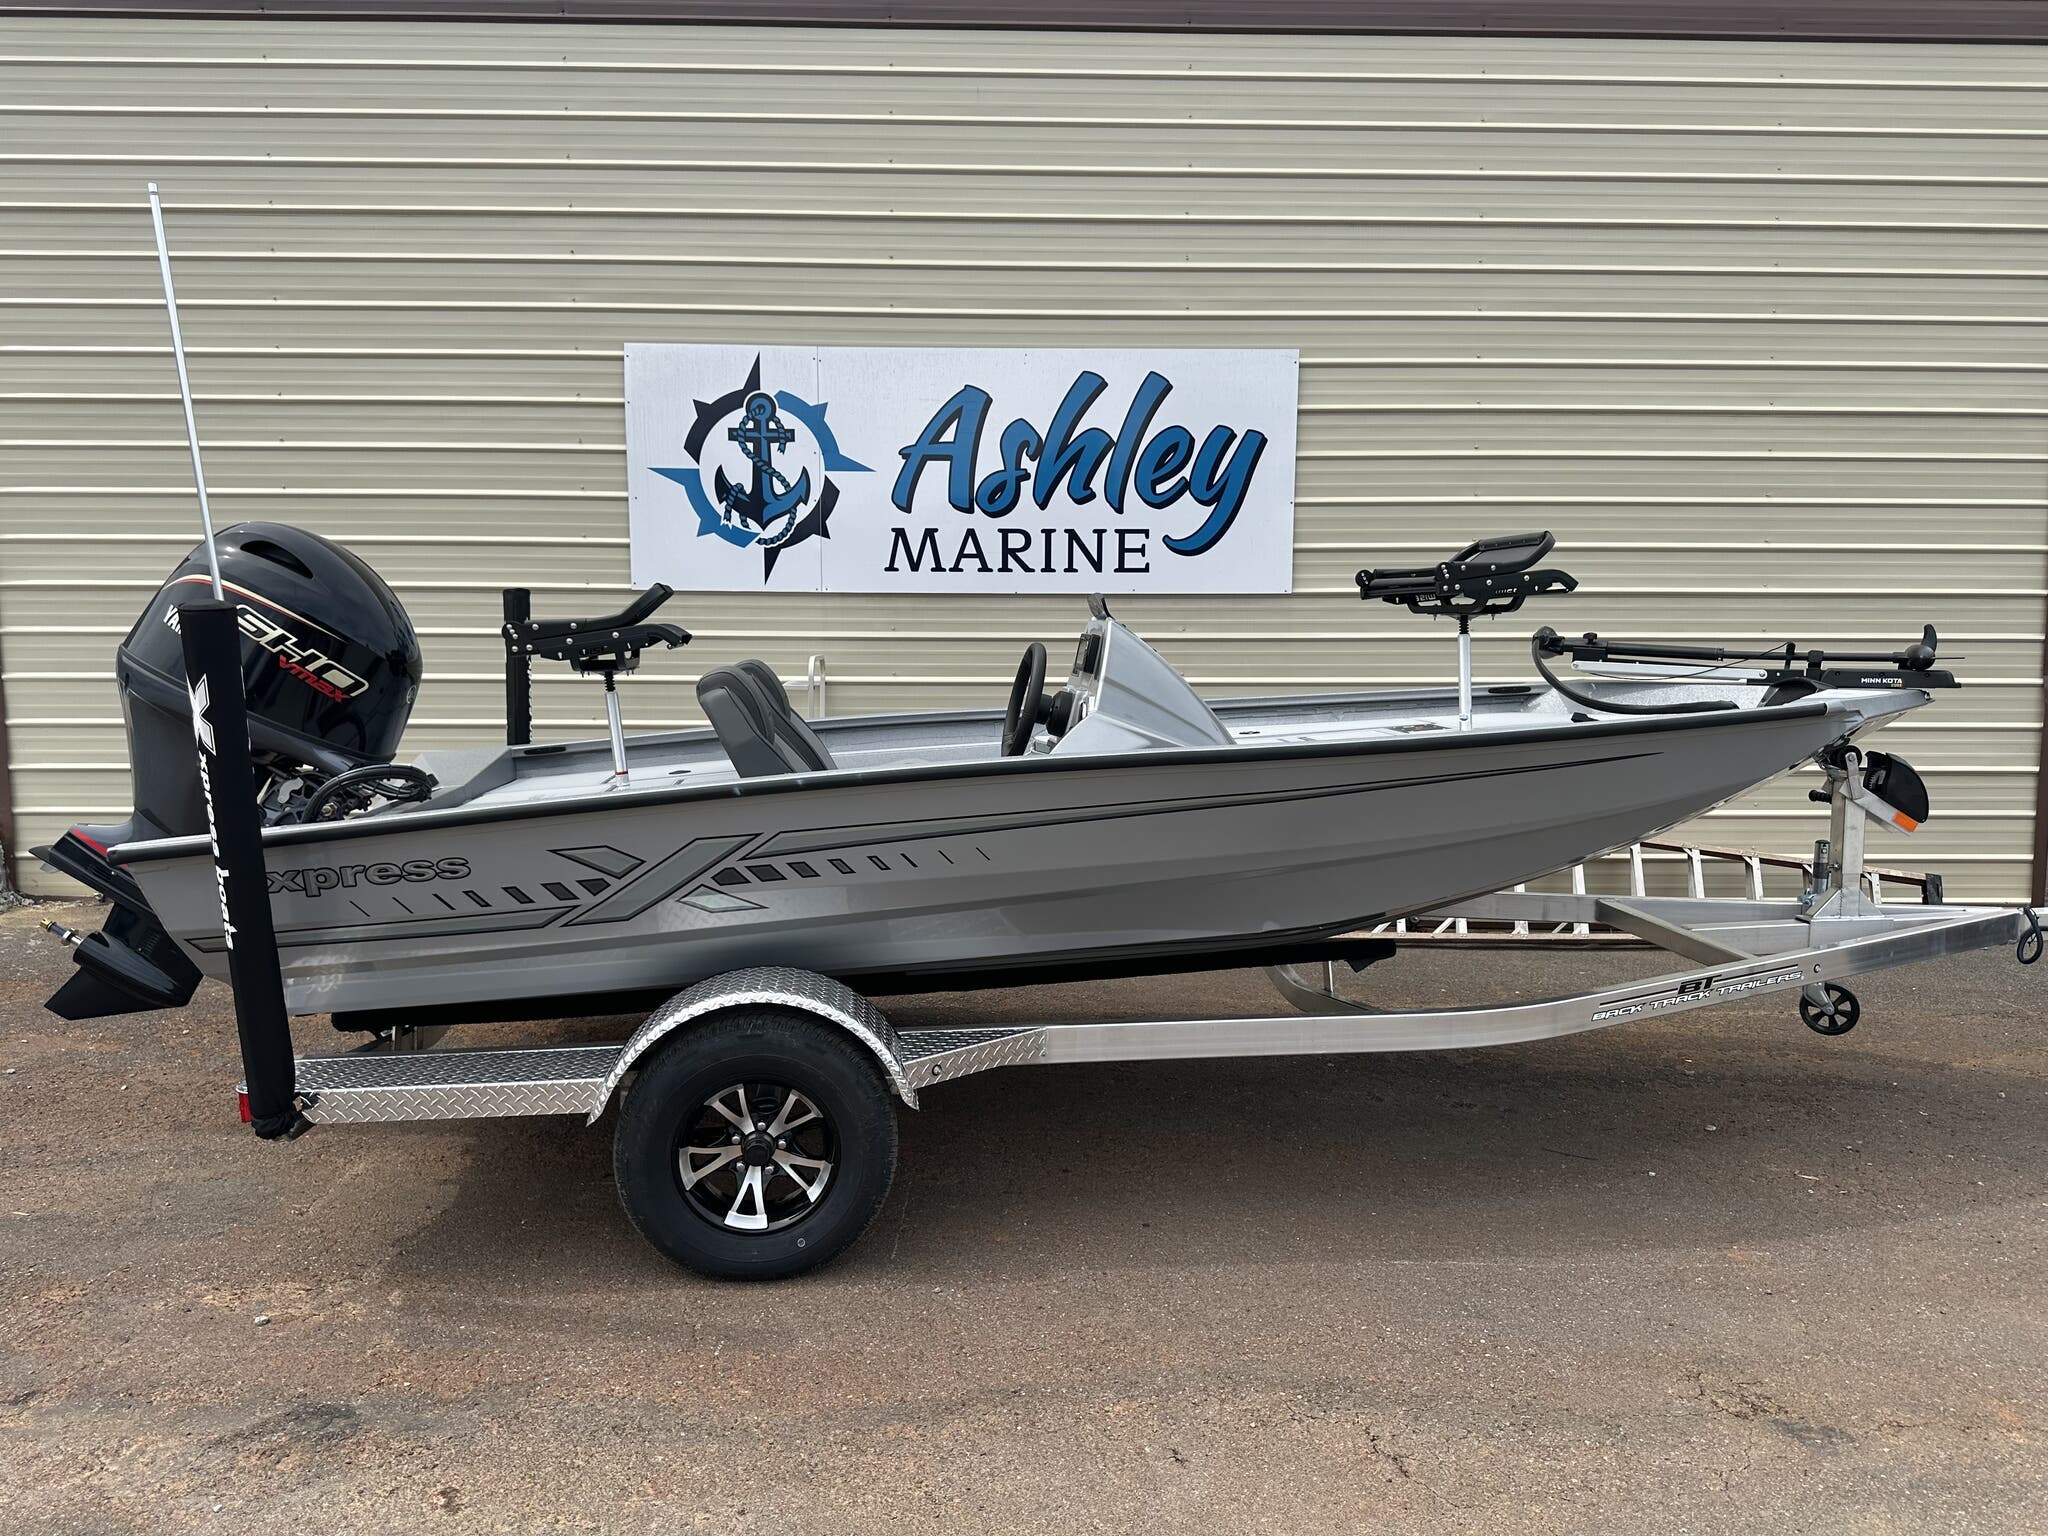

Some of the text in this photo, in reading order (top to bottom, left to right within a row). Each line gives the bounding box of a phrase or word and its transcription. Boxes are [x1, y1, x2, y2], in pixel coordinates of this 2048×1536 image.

[891, 370, 1268, 557] Ashley
[884, 527, 1151, 574] MARINE
[236, 604, 370, 697] SHO
[198, 752, 221, 859] xpress
[215, 865, 238, 951] boats
[1591, 971, 1802, 1022] BACK TRACK TRAILERS
[1677, 974, 1722, 995] BT
